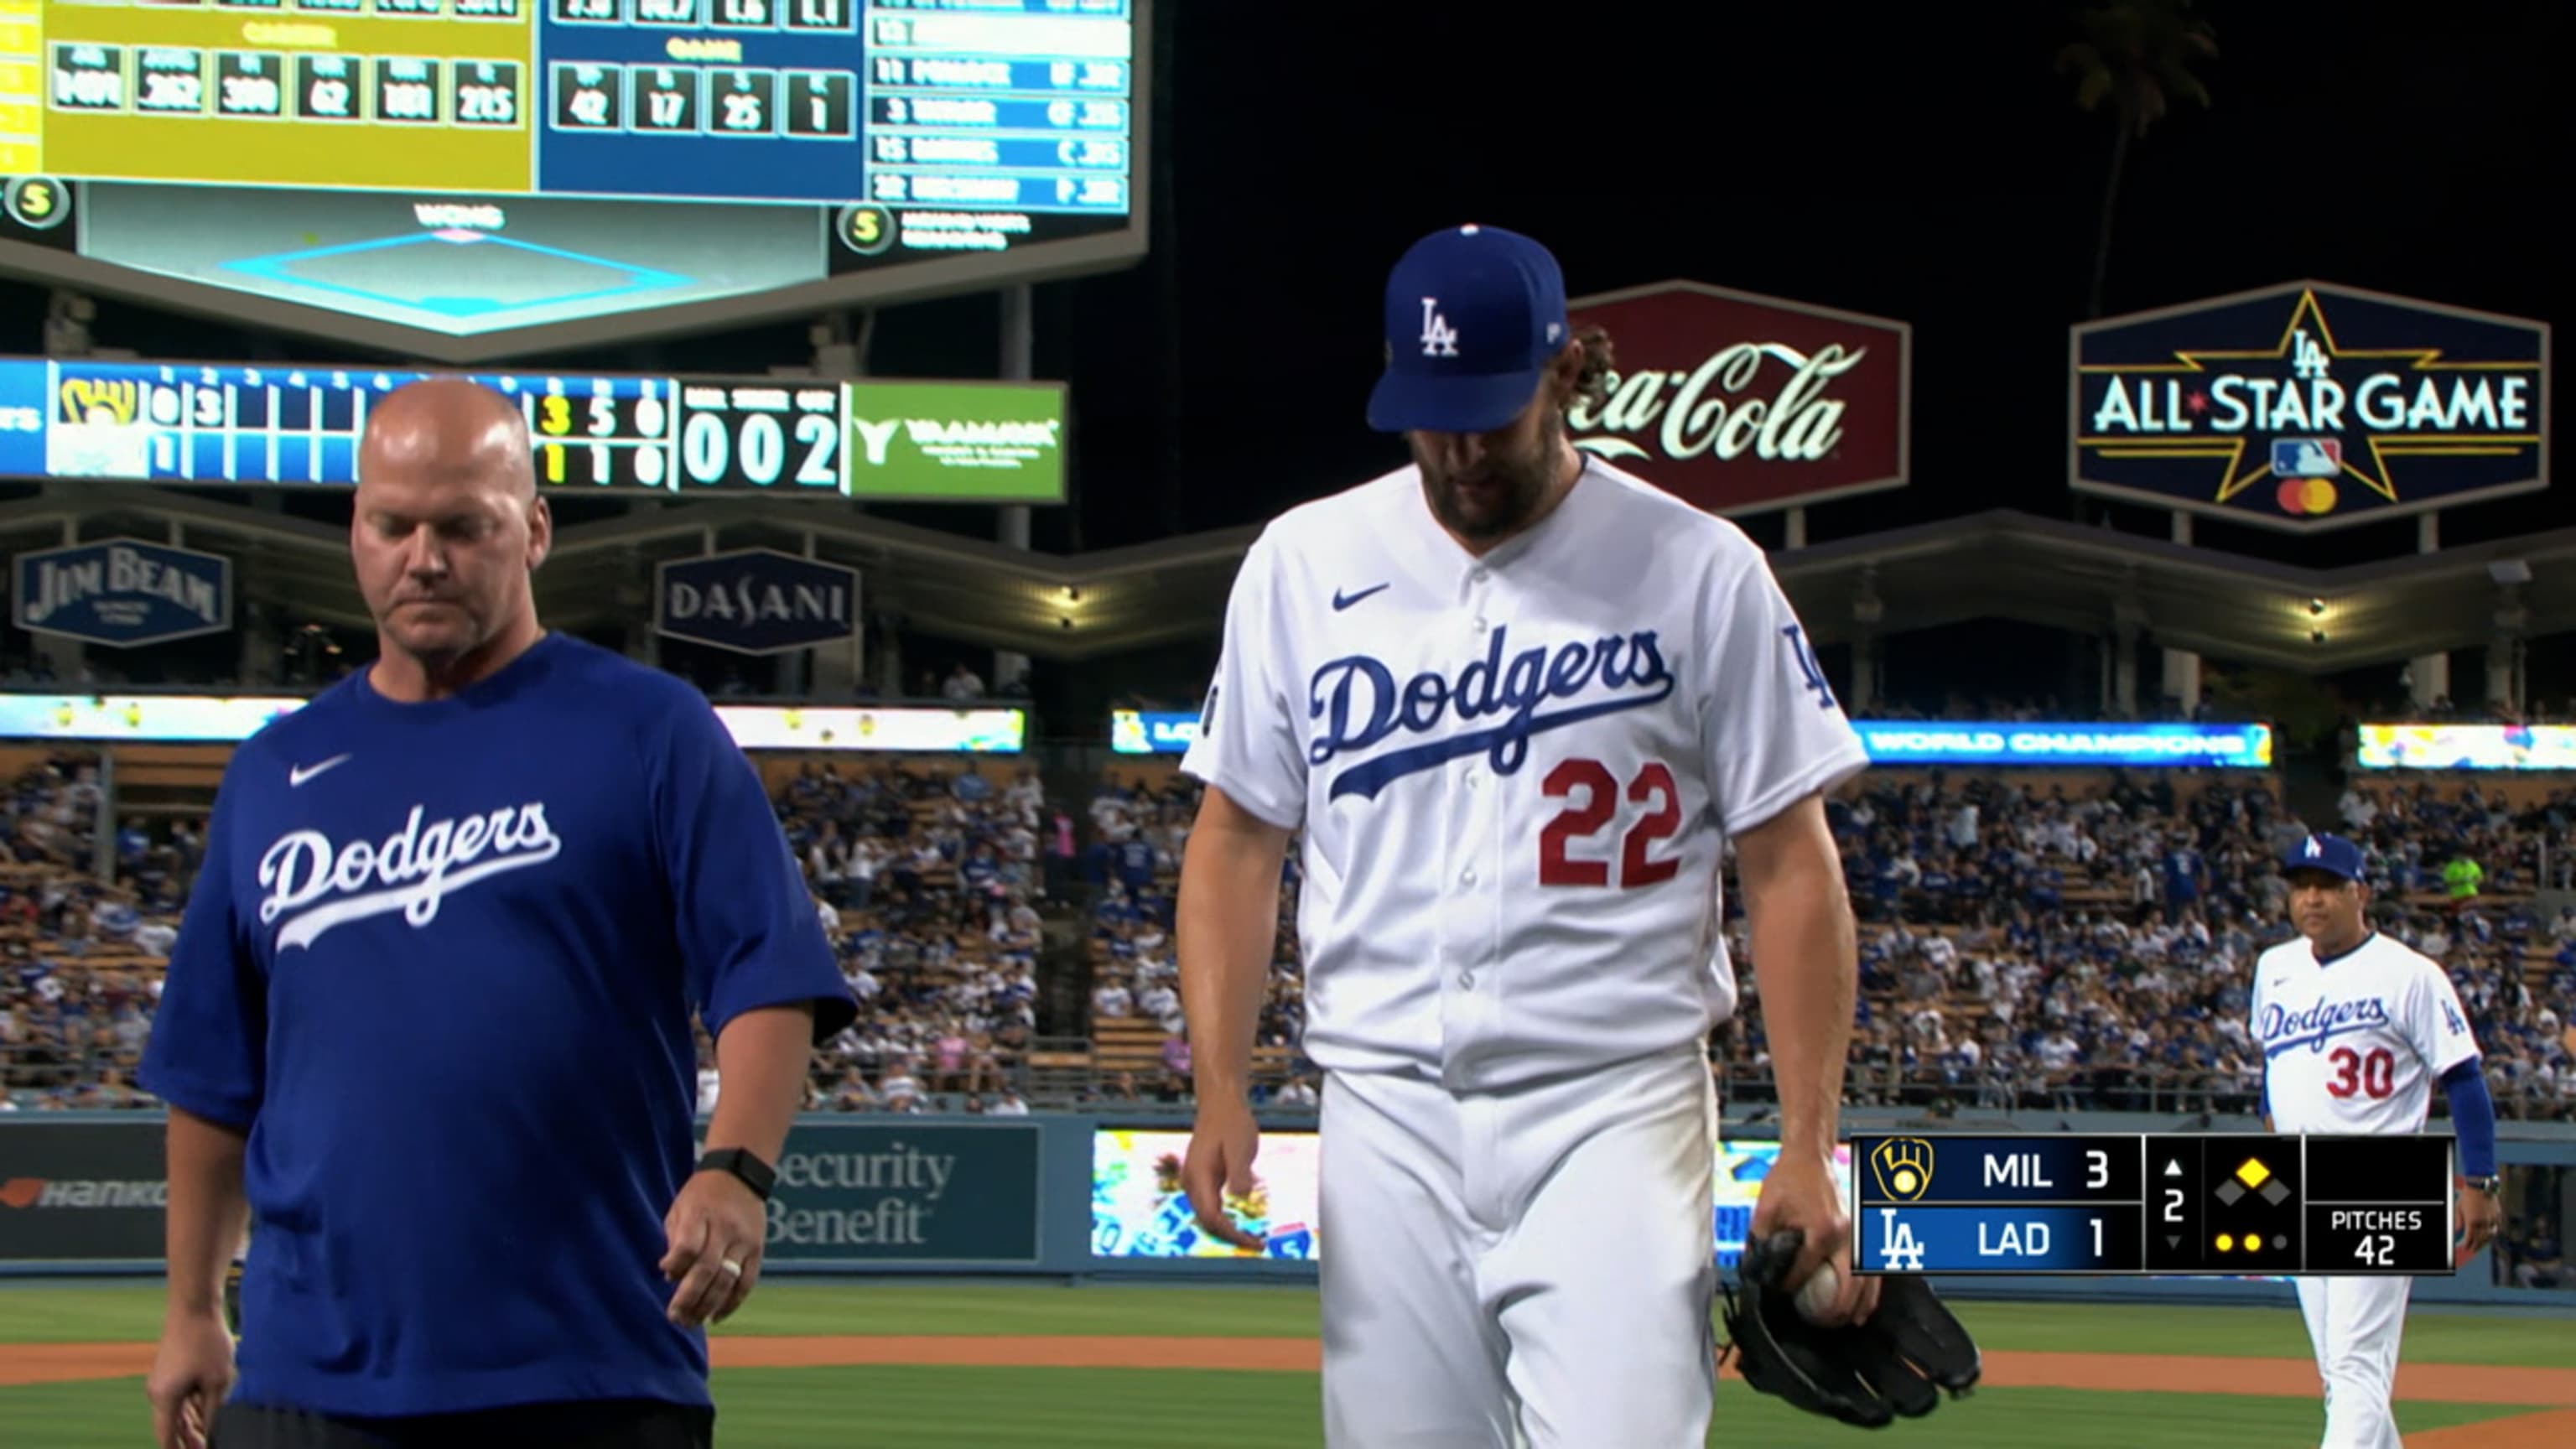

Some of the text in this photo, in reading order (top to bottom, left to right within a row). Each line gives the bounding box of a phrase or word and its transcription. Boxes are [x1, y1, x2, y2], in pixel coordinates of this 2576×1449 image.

[20, 182, 51, 216] 5
[852, 210, 879, 242] 5
[1420, 296, 1459, 356] LA
[2293, 330, 2329, 379] LA
[152, 386, 664, 439] 0 3 3 5 0
[1568, 342, 1870, 461] ca-Cola
[2094, 373, 2528, 432] ALL STAR GAME
[546, 444, 565, 484] 1
[590, 444, 611, 486] 1
[634, 446, 664, 486] 0
[684, 412, 838, 486] 0 0 2
[25, 547, 217, 623] JIM BEAM
[670, 574, 844, 629] DASANI
[1309, 625, 1675, 803] Dodgers
[1868, 731, 2246, 755] WORLD CHAMPIONS
[1540, 758, 1683, 888] 22
[258, 802, 561, 951] Dodgers
[2262, 995, 2390, 1060] Dodgers
[2326, 1046, 2395, 1100] 30
